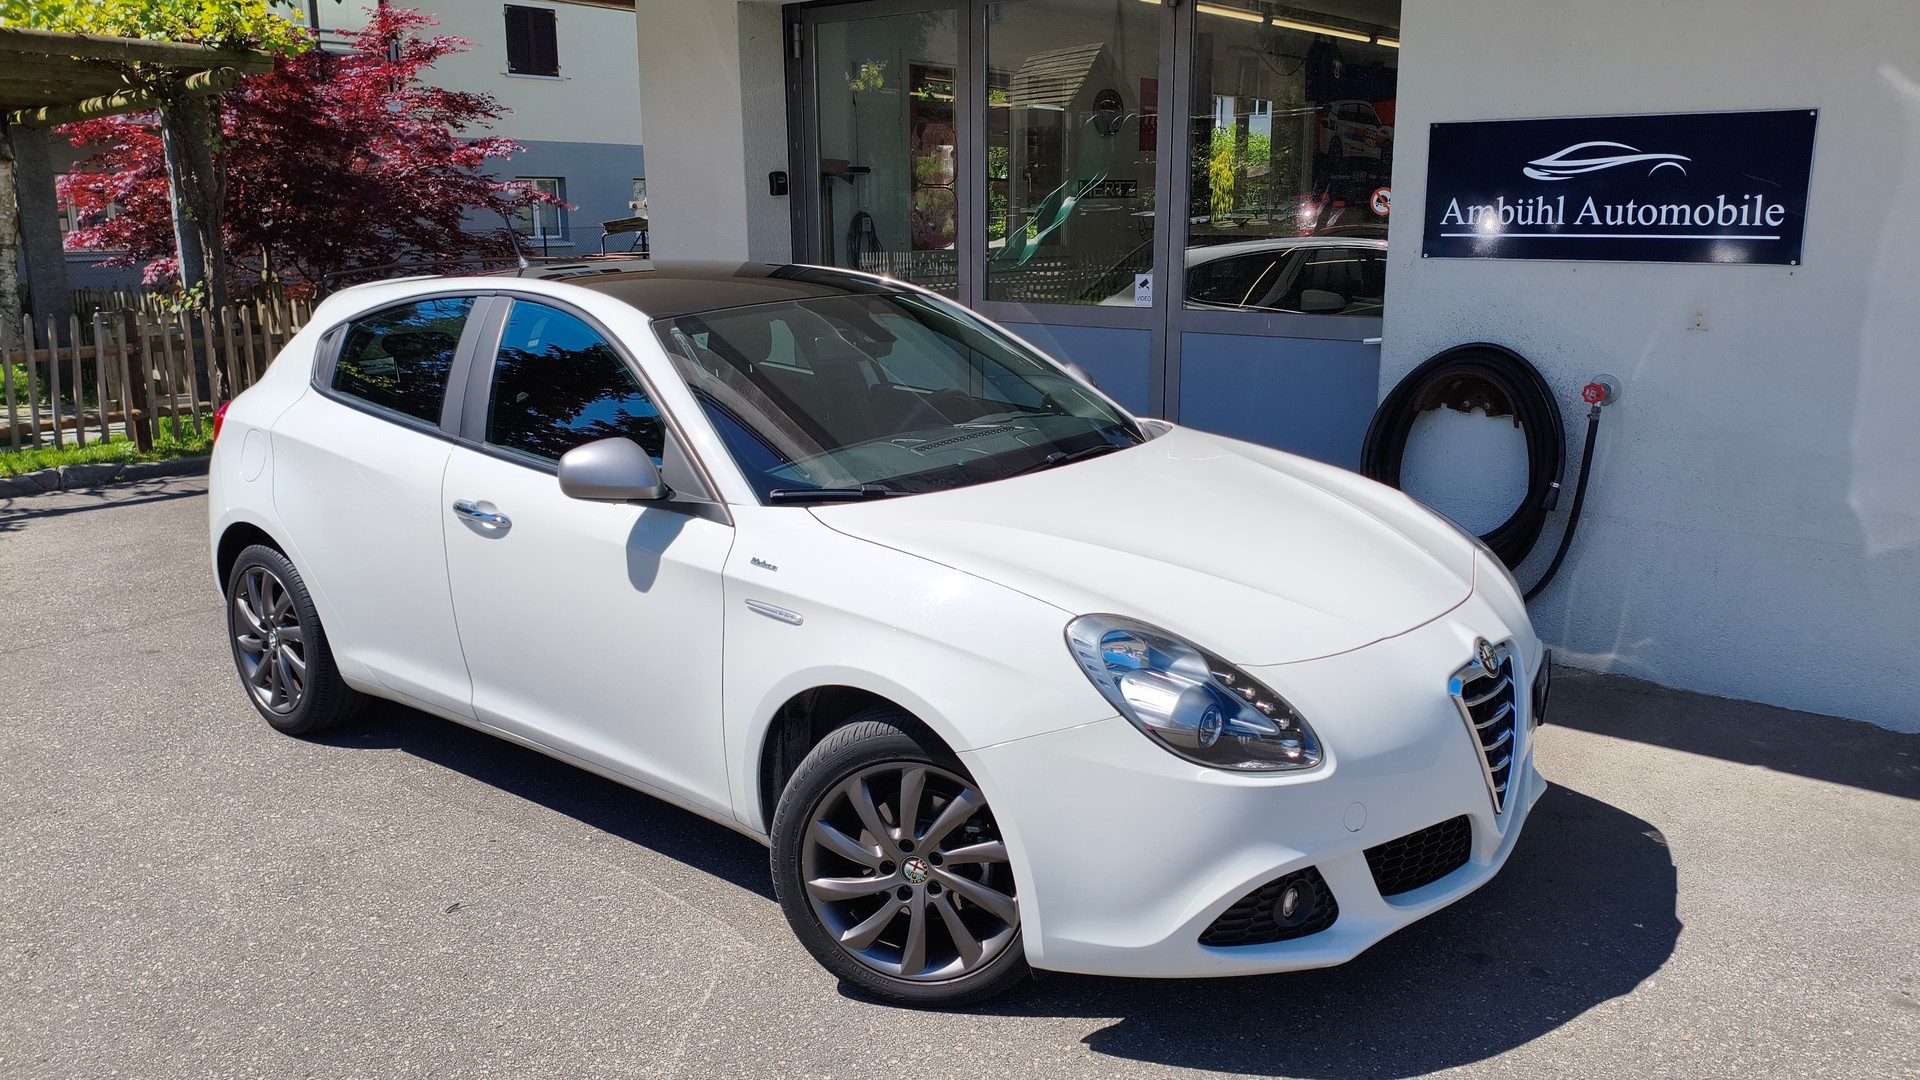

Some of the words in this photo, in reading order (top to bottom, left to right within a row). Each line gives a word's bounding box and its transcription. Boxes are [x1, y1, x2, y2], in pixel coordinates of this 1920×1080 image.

[1079, 181, 1137, 197] HERTZ
[1440, 196, 1566, 226] Ambühl
[1573, 194, 1785, 227] Automobile
